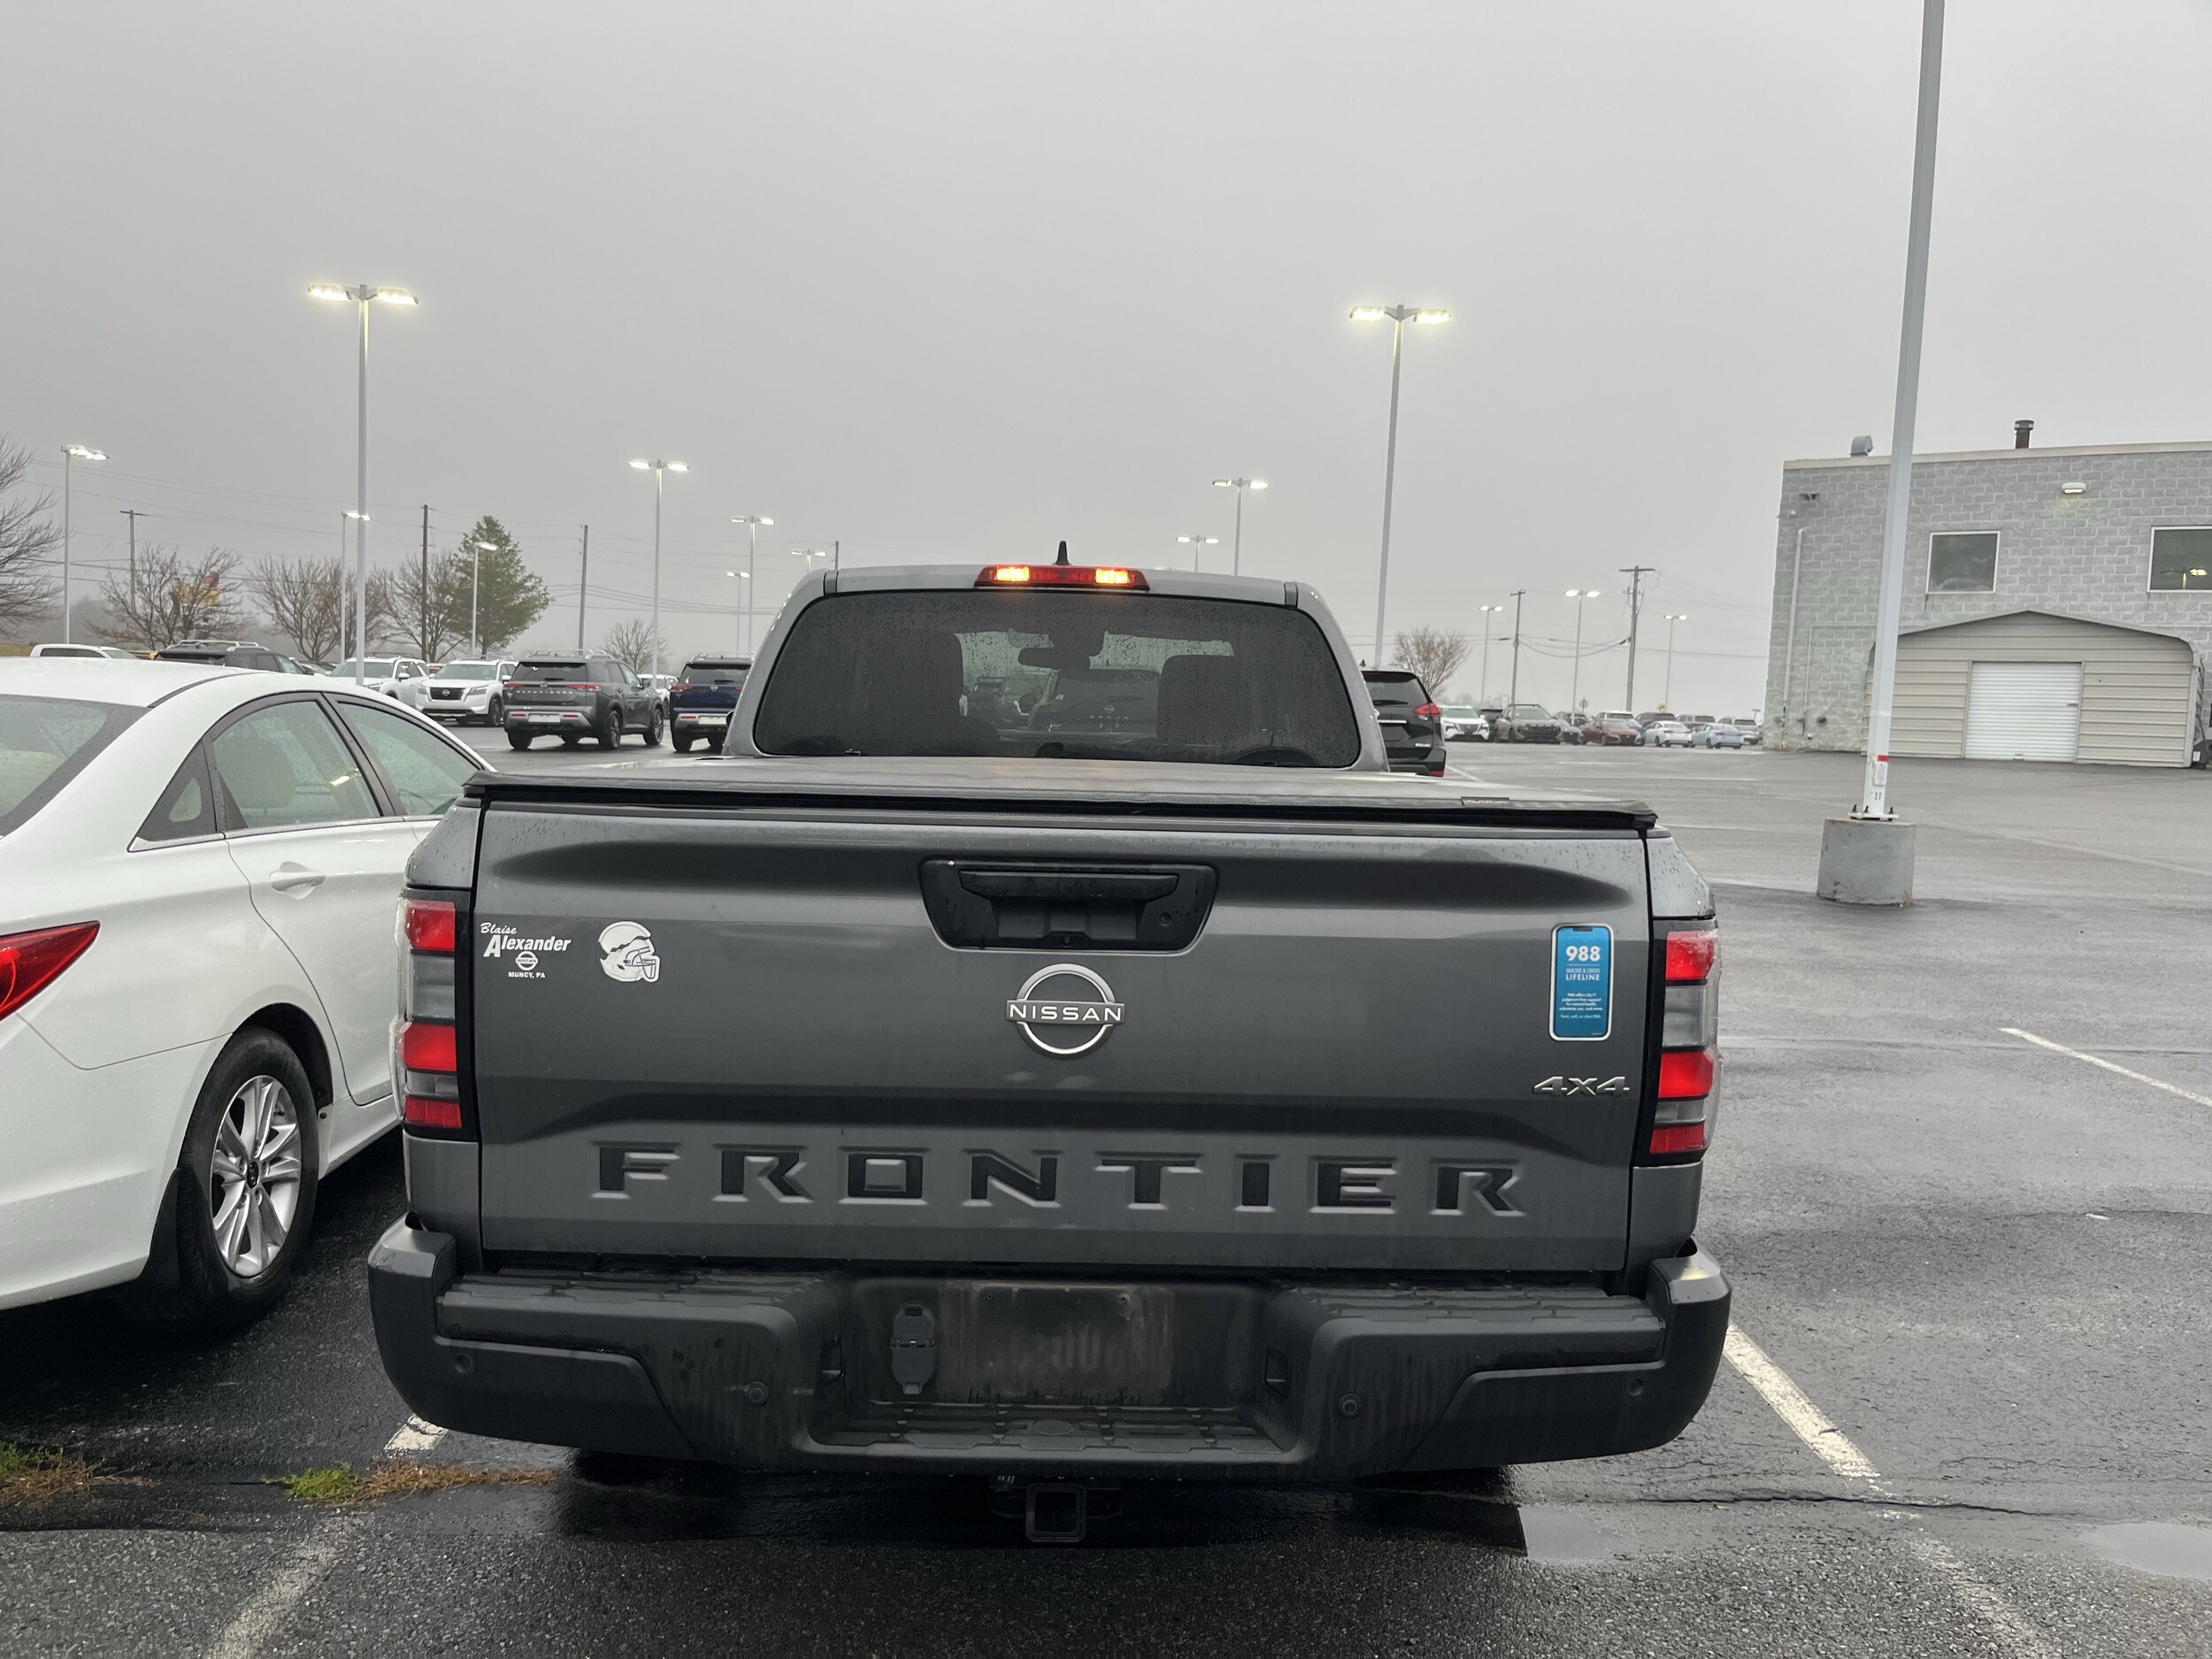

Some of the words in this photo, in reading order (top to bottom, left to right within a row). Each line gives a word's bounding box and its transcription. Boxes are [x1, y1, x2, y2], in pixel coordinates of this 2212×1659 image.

[480, 922, 517, 934] Blaise
[483, 934, 572, 957] Alexander
[1565, 945, 1601, 962] 988
[1010, 1003, 1121, 1022] NISSAN
[591, 1144, 1525, 1217] FRONTIER
